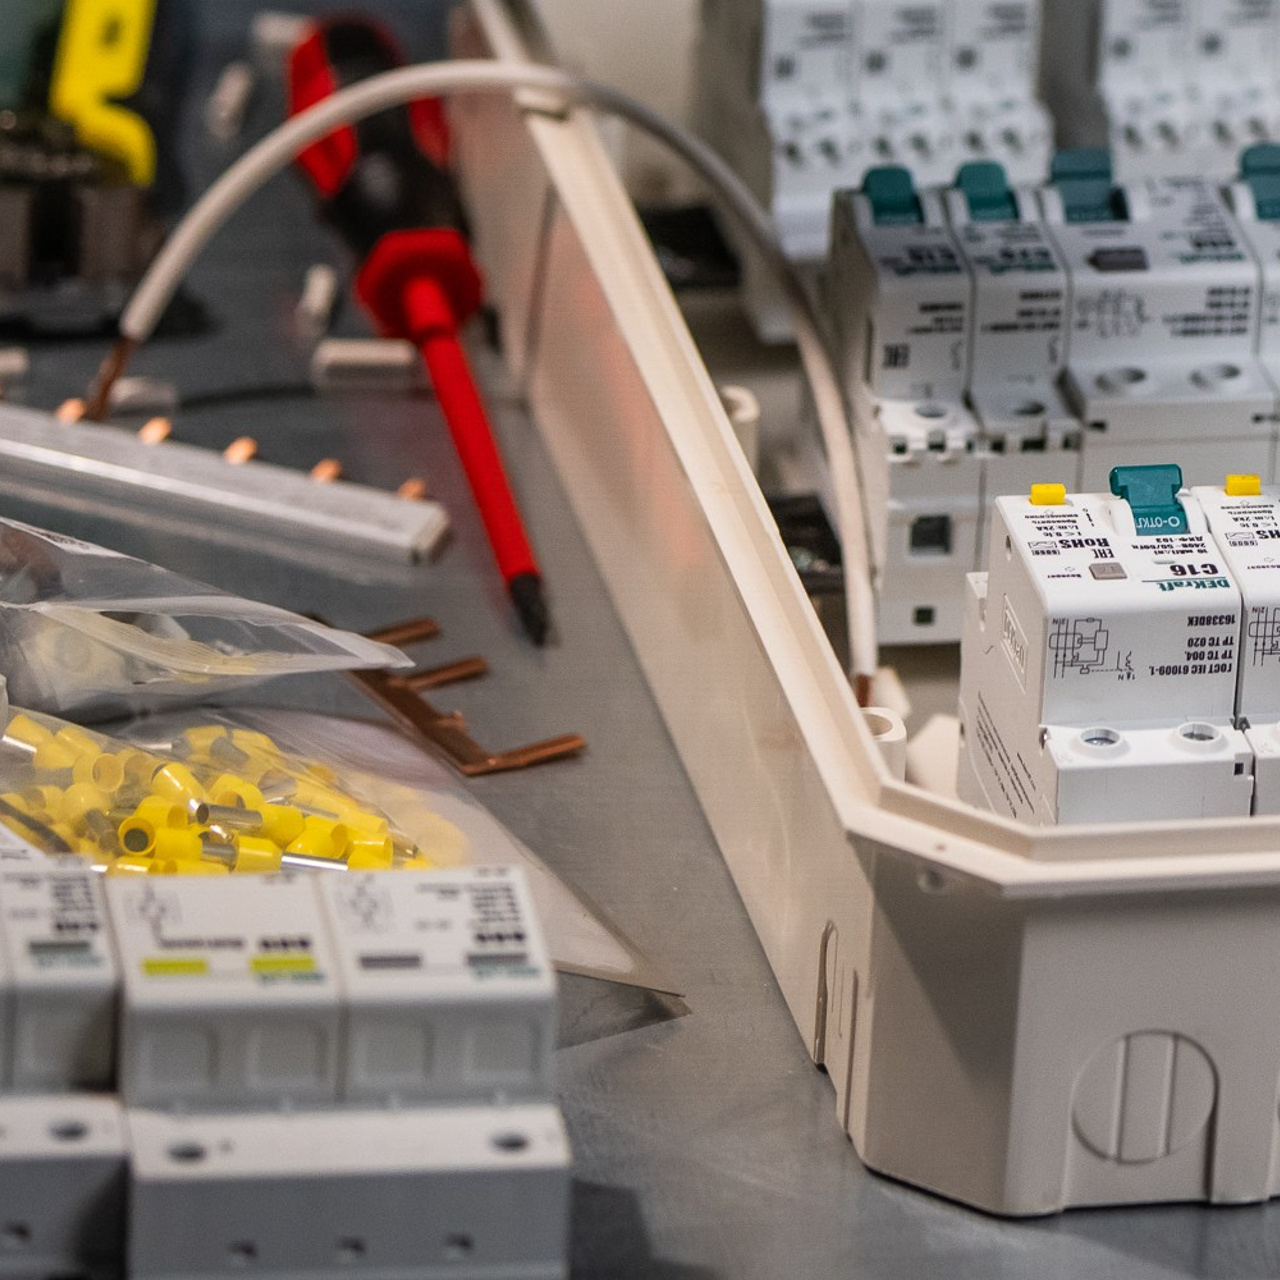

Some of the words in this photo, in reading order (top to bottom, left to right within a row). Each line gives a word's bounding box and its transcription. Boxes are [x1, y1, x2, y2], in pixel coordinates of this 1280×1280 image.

[1059, 538, 1110, 549] RoHS
[1170, 564, 1219, 576] C16
[1157, 579, 1230, 591] DEKraft
[1188, 614, 1236, 627] 16338DEK
[1188, 638, 1207, 648] 020
